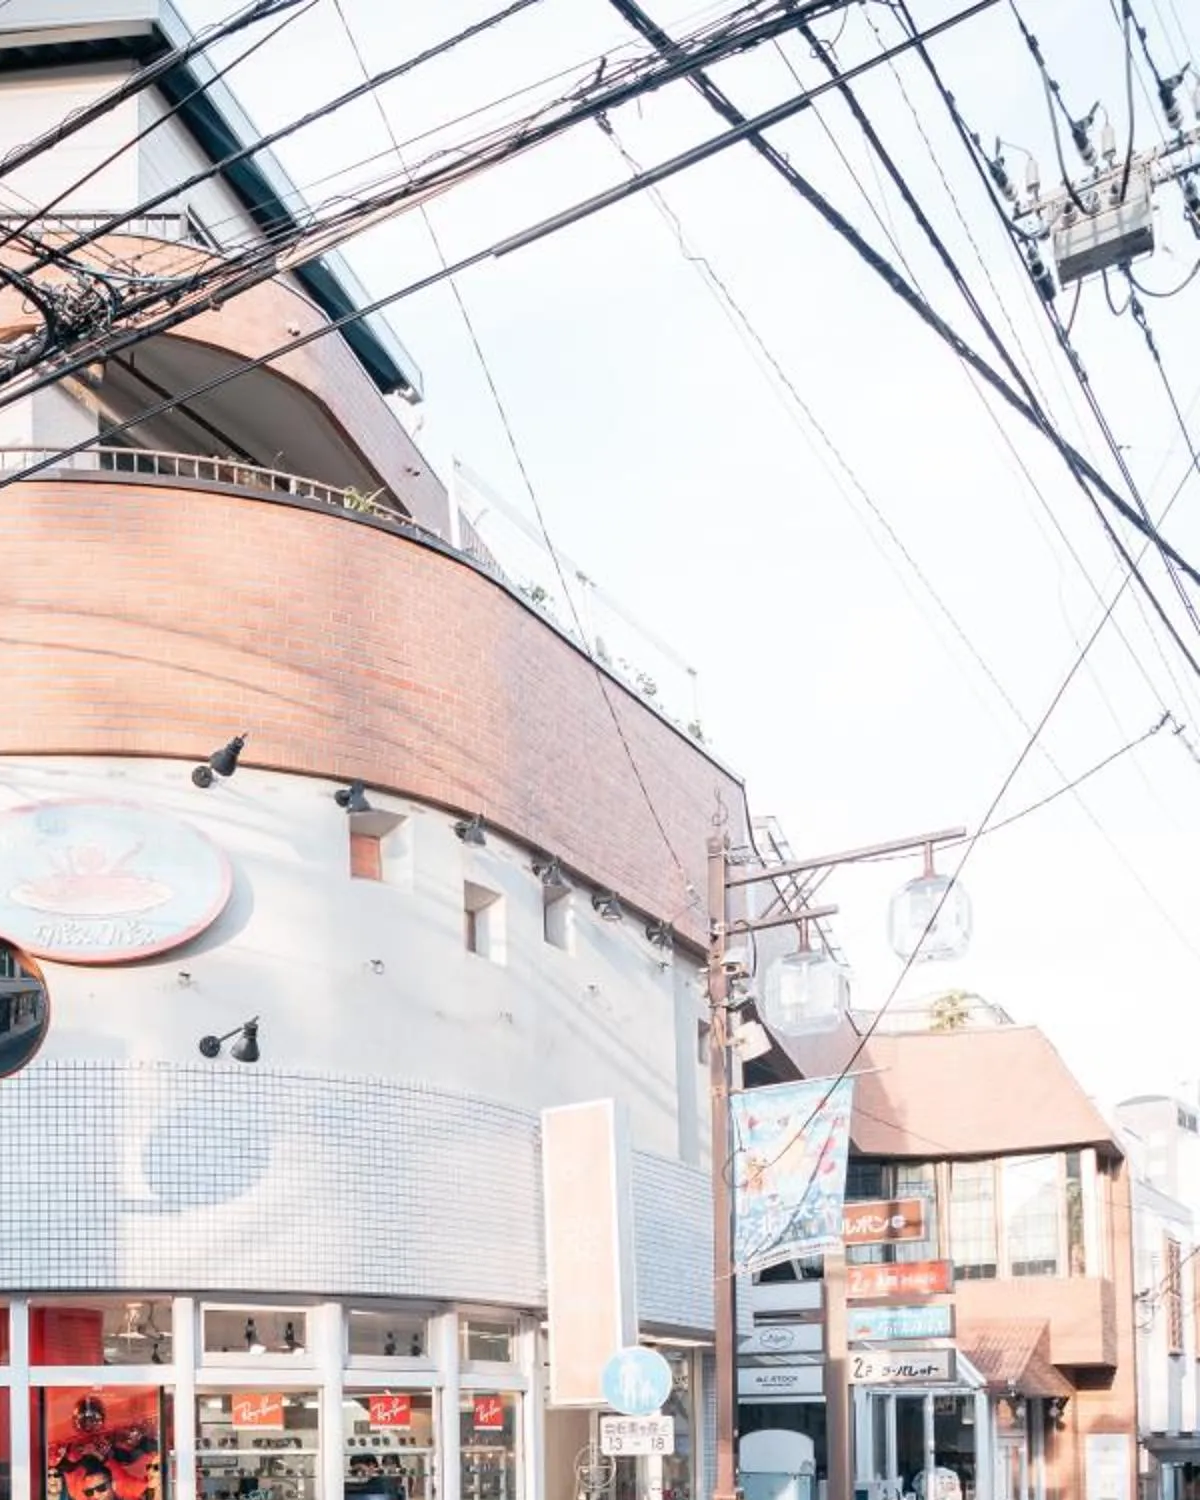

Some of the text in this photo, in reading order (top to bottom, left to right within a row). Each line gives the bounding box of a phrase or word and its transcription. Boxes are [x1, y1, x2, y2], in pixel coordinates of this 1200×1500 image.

[232, 1396, 280, 1421] Ray-Ban
[371, 1398, 407, 1421] Ray-Ban
[650, 1437, 665, 1451] 18
